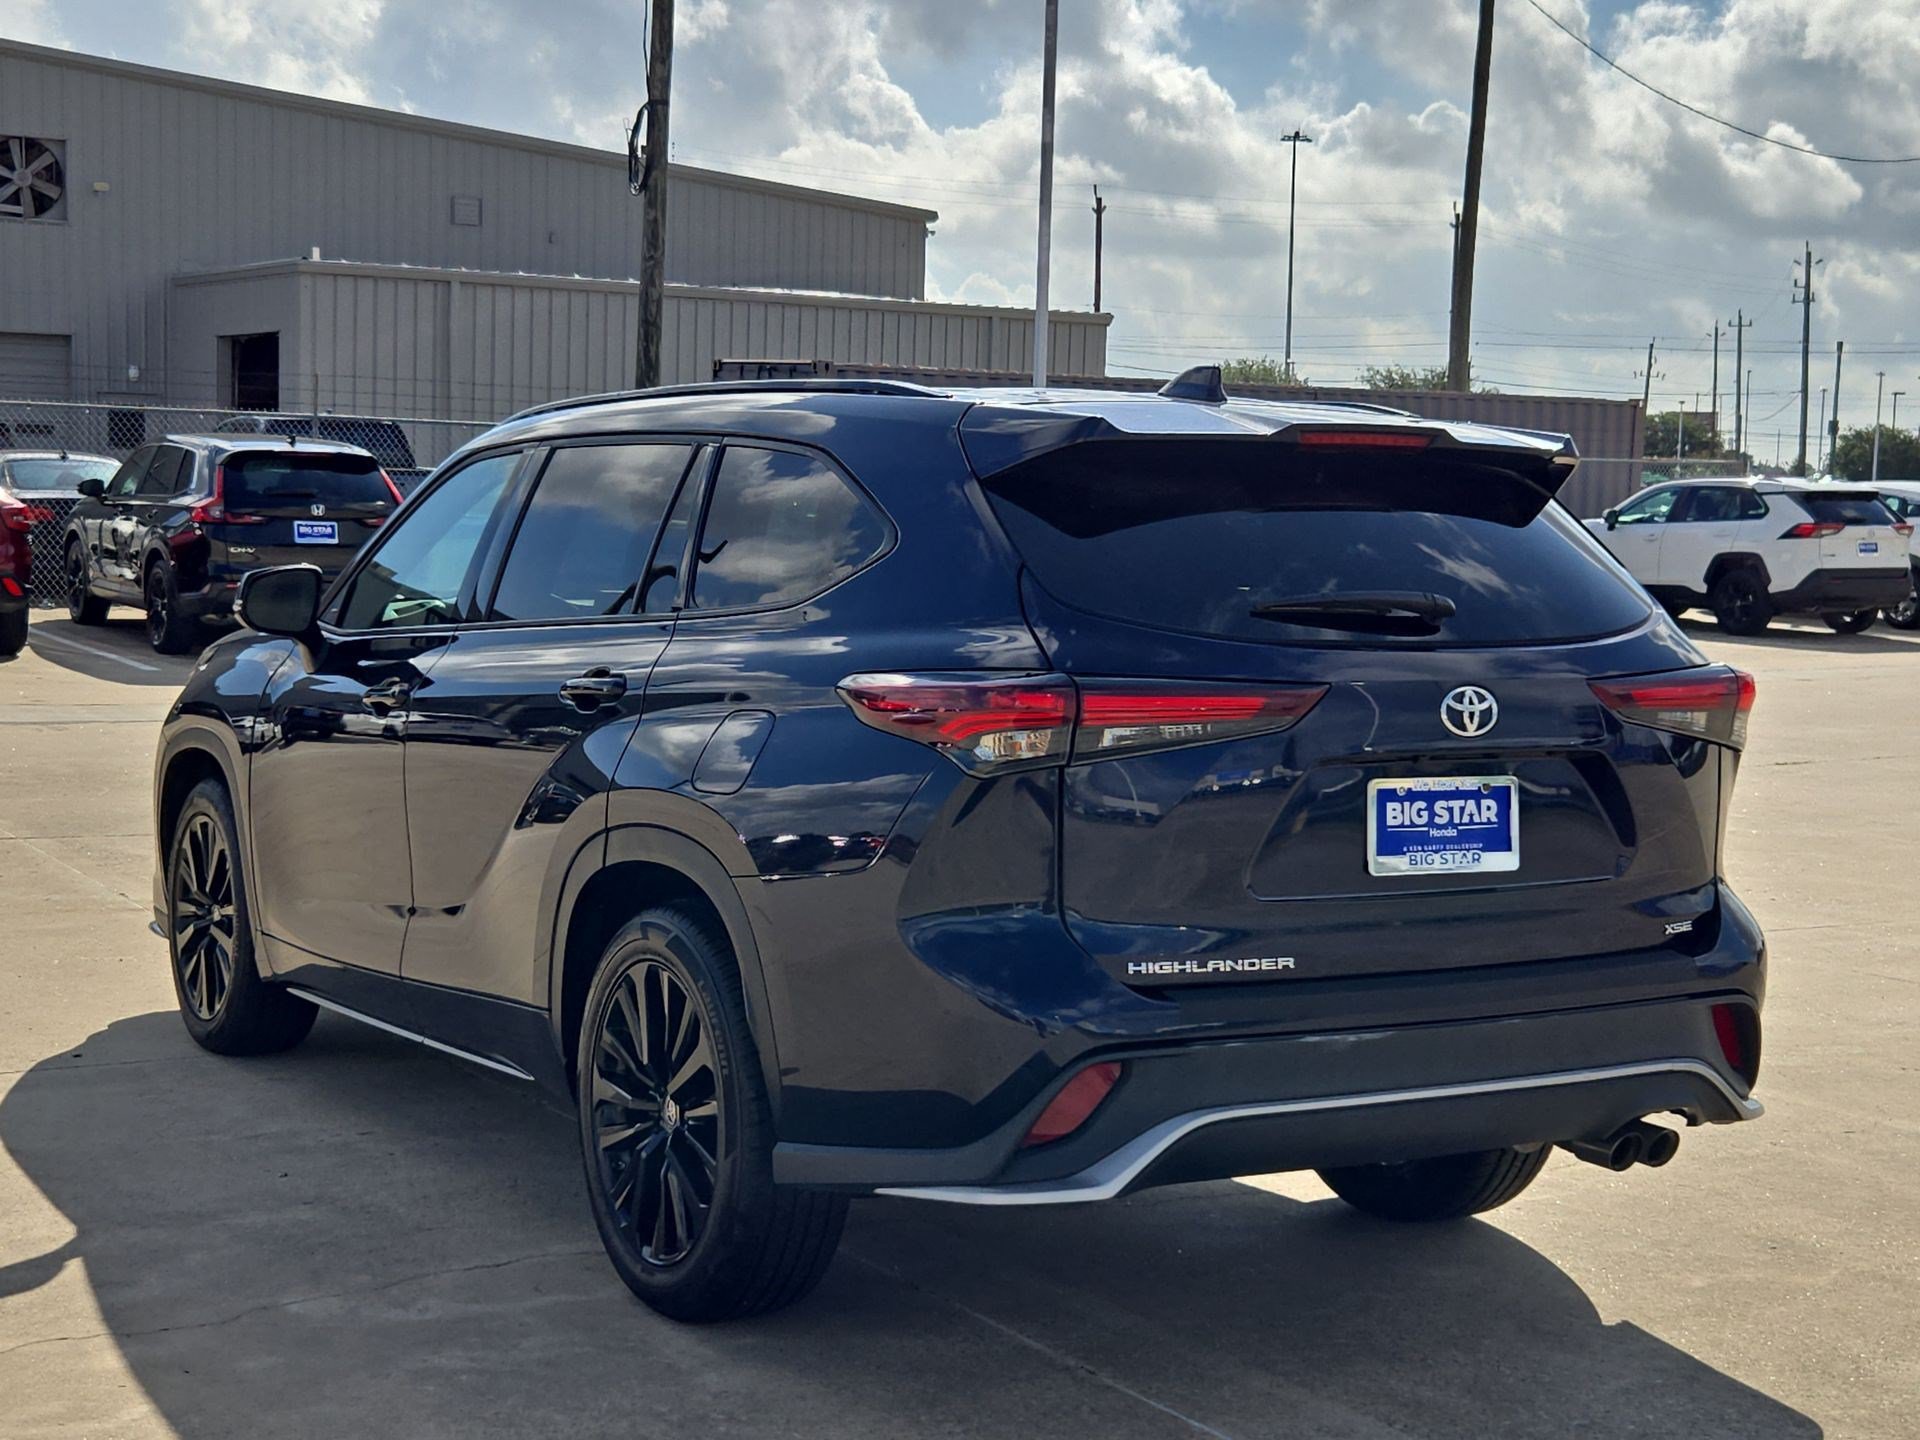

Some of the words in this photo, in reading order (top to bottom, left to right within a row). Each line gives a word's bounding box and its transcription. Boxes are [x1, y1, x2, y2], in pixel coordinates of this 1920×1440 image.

[1386, 801, 1428, 826] BIG
[1434, 799, 1498, 824] STAR
[1429, 827, 1457, 837] Honda
[1409, 853, 1435, 866] BIG
[1440, 852, 1481, 865] STAR
[1664, 920, 1693, 935] XSE
[1127, 957, 1295, 974] HIGHLANDER
